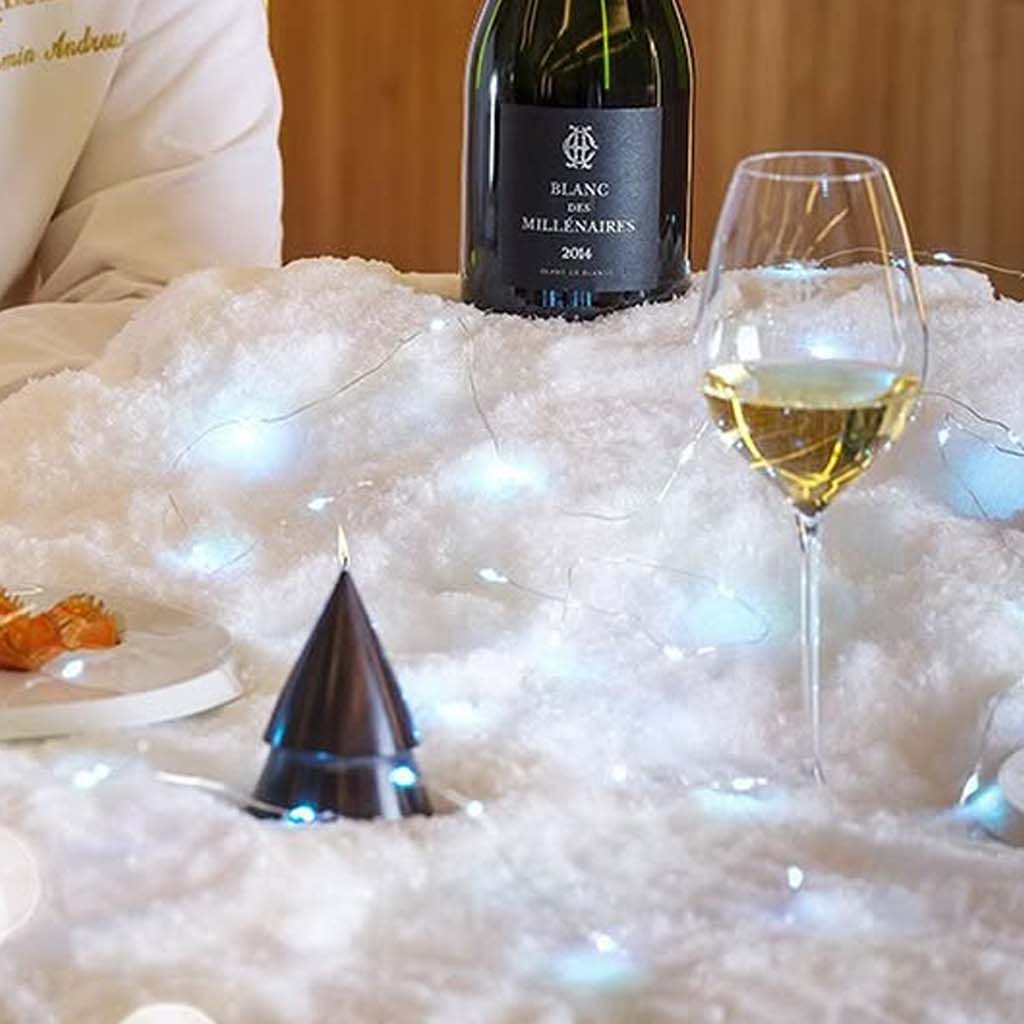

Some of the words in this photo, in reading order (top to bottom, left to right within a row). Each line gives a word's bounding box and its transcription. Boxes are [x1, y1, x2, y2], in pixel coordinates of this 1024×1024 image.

[550, 181, 610, 197] BLANC
[567, 202, 591, 213] DES
[521, 215, 636, 233] MILLÉNAIRES
[561, 246, 593, 260] 2014
